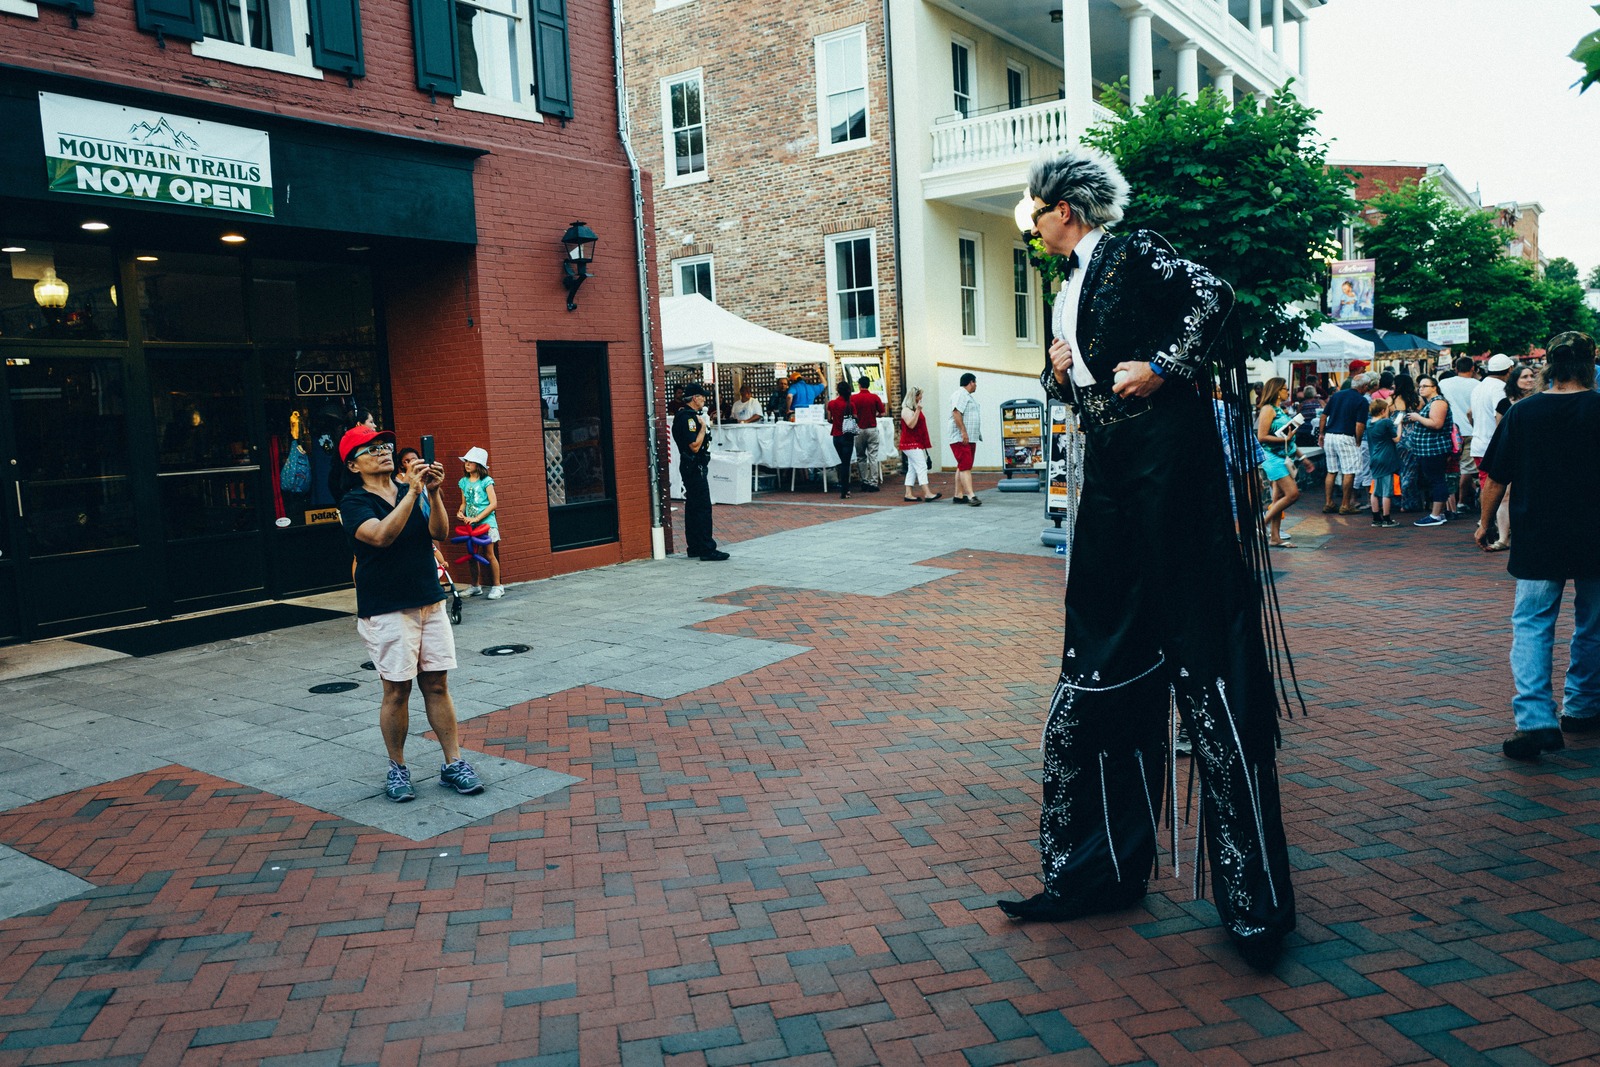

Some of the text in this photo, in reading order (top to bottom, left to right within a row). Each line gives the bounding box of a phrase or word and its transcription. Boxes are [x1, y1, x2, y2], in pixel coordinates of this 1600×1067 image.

[58, 137, 261, 182] MOUNTAIN TRAILS
[75, 165, 251, 209] NOW OPEN
[297, 374, 349, 393] OPEN
[1016, 412, 1040, 420] MARKET
